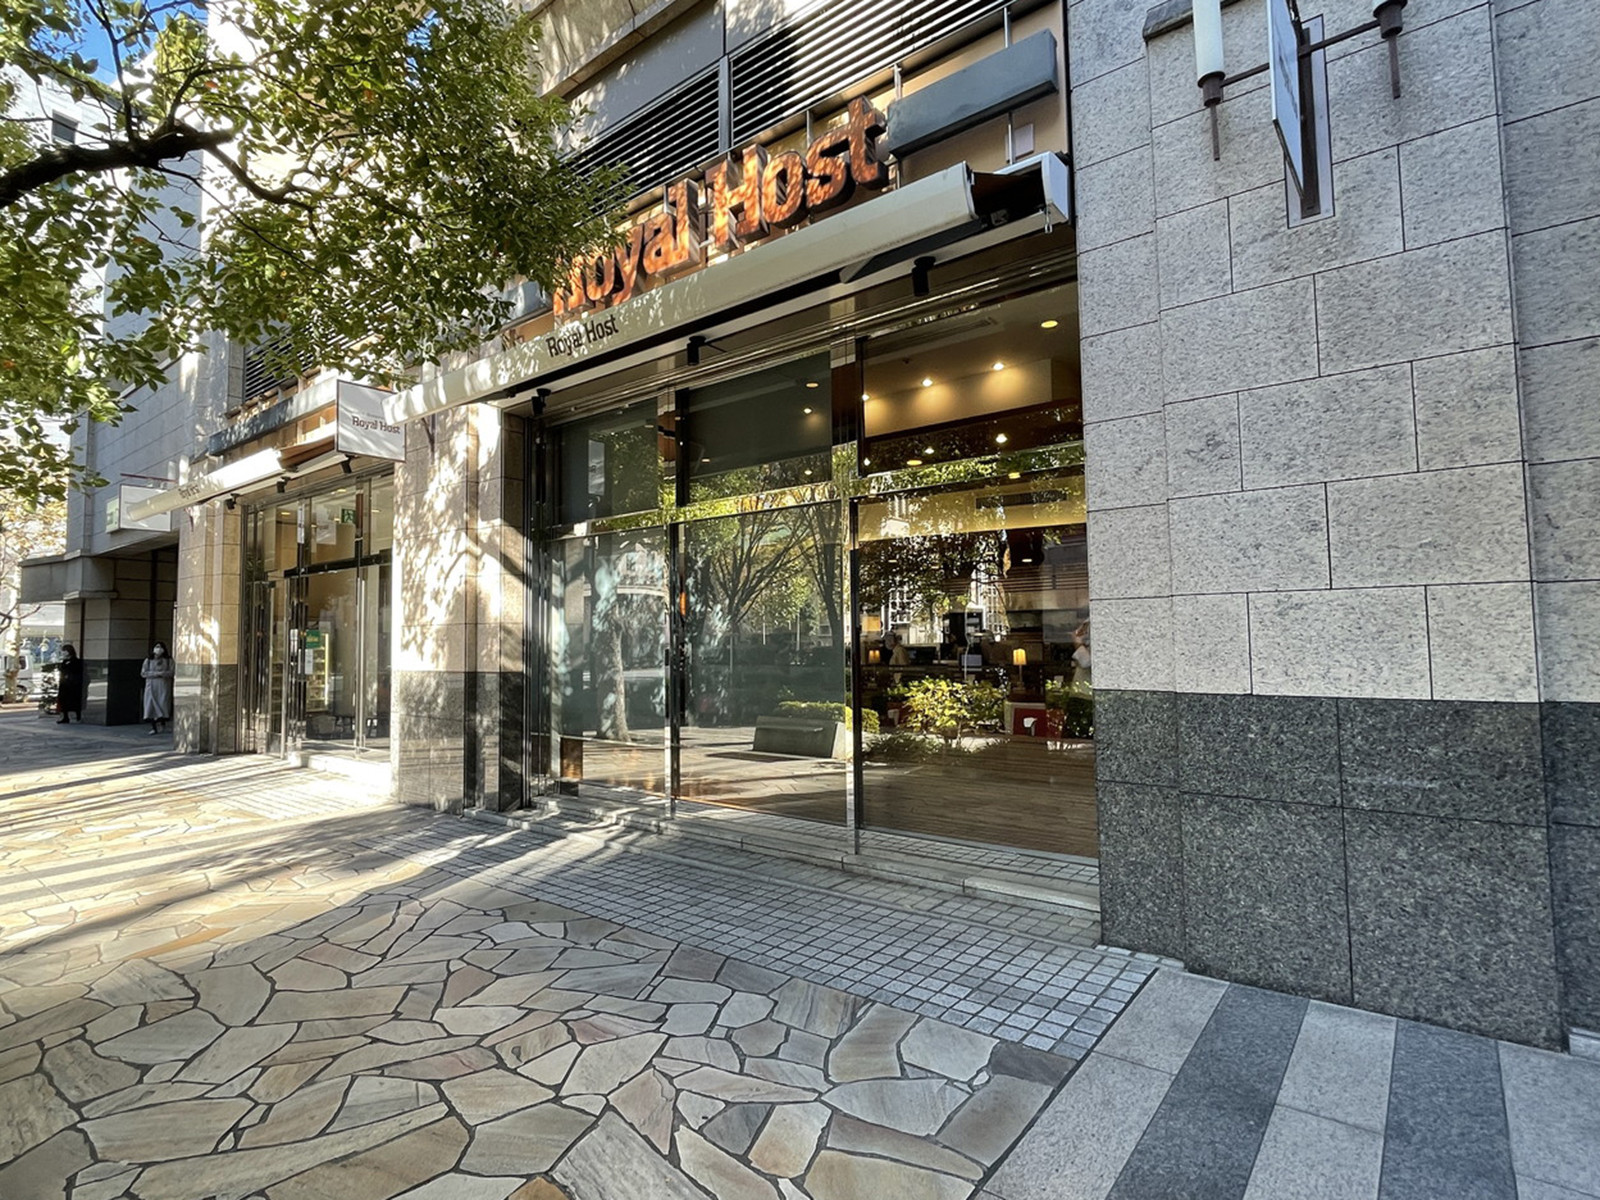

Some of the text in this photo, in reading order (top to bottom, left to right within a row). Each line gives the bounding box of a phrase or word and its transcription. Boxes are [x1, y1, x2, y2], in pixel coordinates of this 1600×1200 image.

[705, 95, 887, 249] Host
[546, 314, 619, 358] Royal Host
[352, 415, 378, 430] Royal
